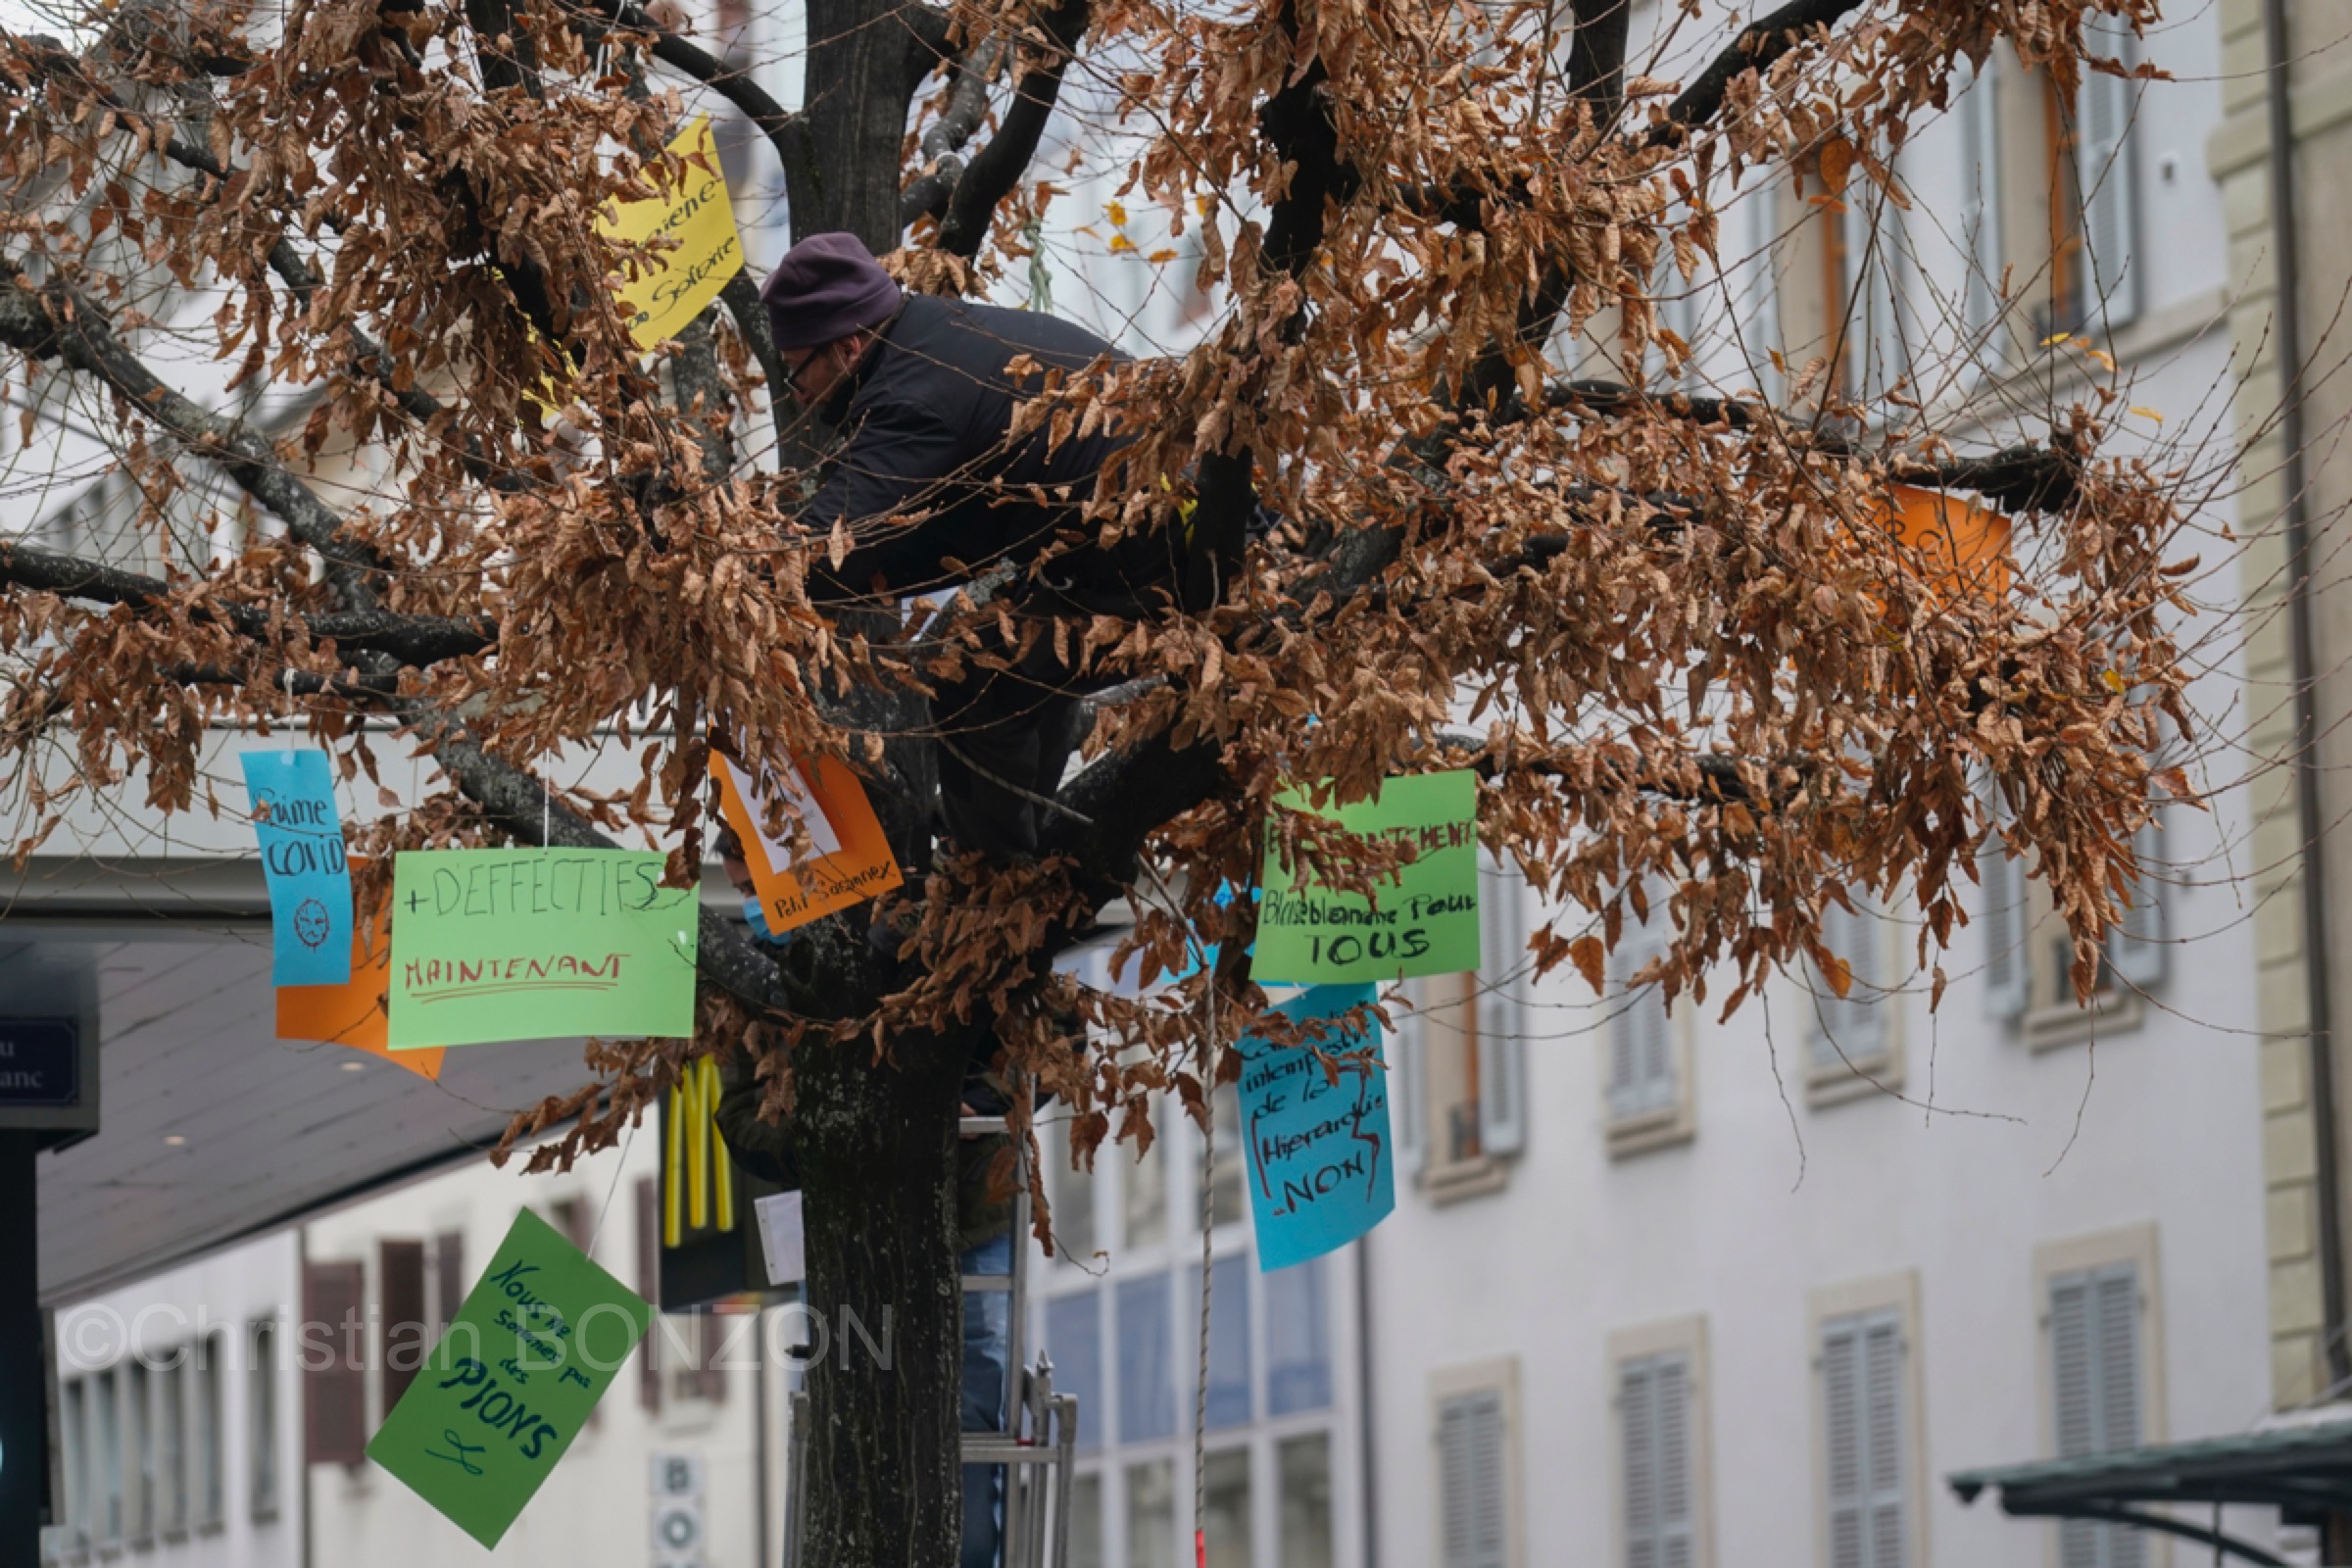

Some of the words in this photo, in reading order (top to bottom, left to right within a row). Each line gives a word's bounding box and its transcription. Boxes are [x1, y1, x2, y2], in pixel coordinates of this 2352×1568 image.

[1304, 928, 1431, 965] TOUS
[405, 953, 632, 990] MAINTENANT
[437, 1356, 558, 1460] PIONS
